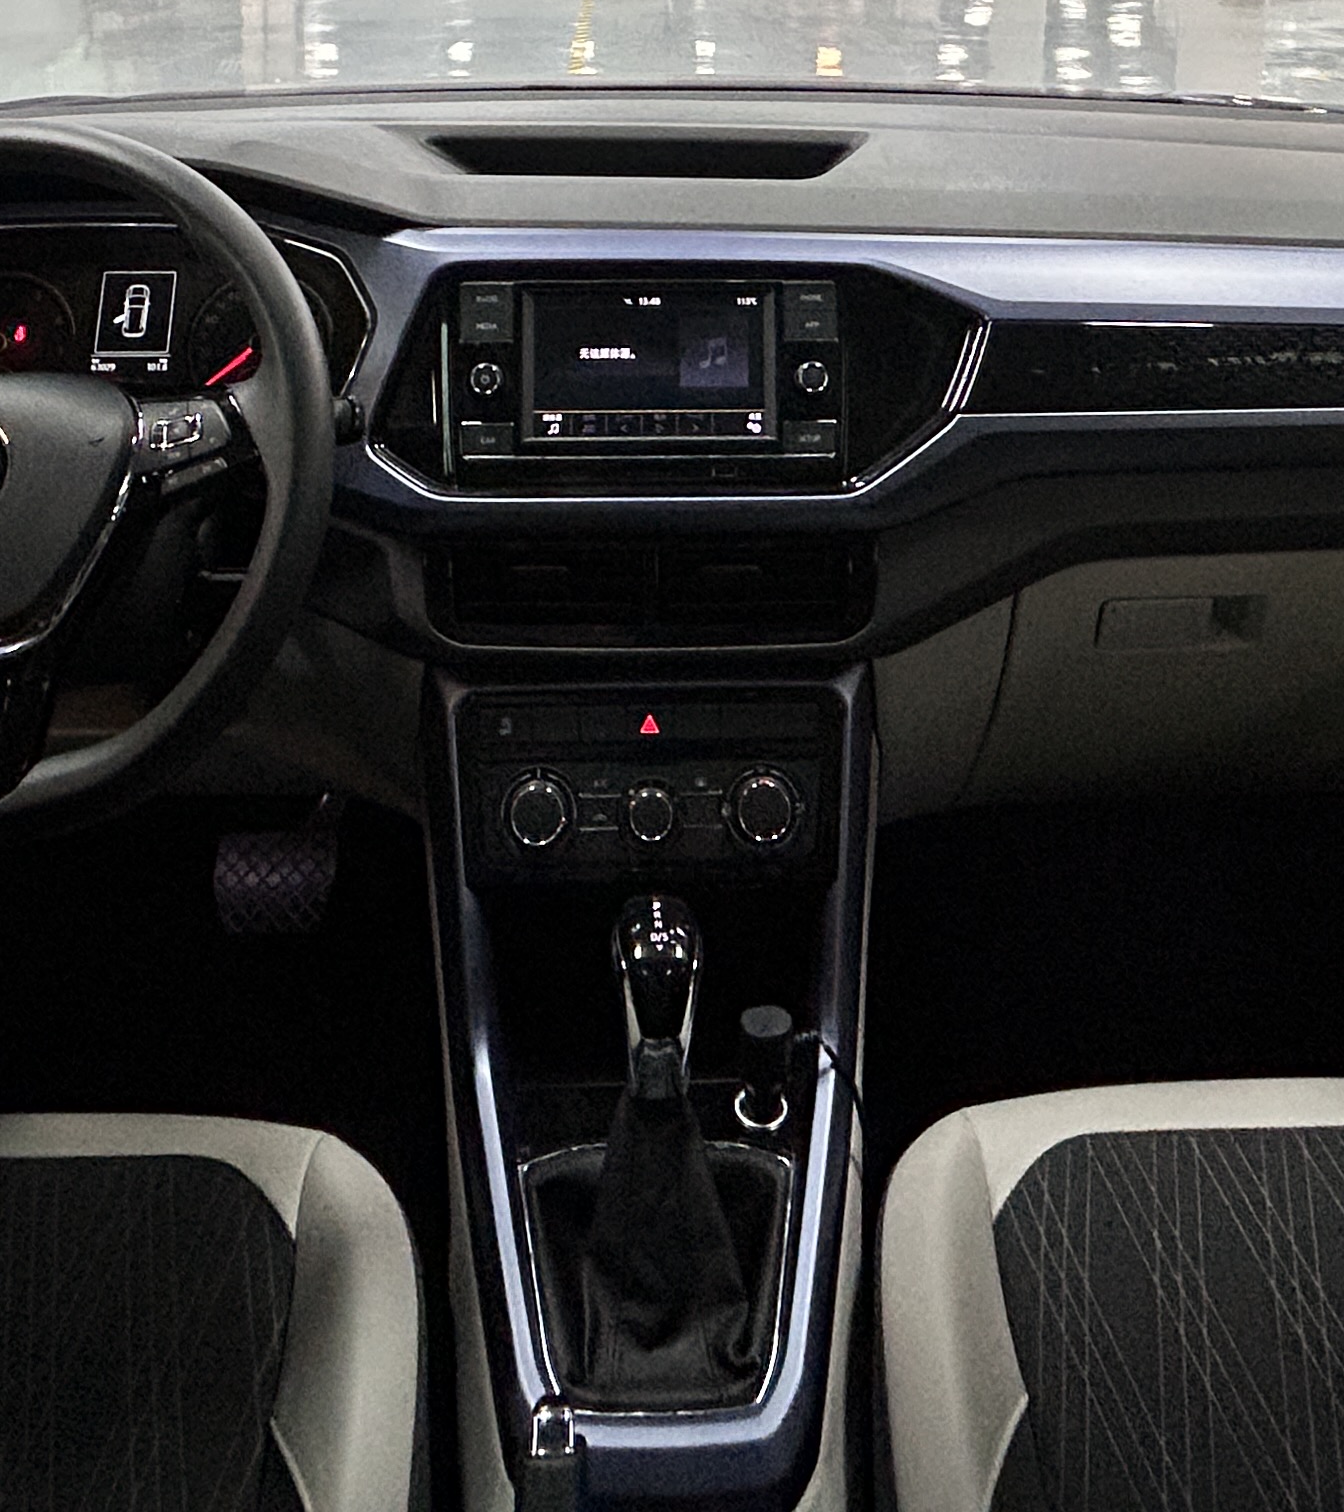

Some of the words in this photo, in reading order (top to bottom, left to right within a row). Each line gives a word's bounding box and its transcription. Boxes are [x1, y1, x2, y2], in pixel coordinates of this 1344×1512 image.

[652, 900, 662, 911] P
[653, 919, 663, 929] N
[649, 931, 669, 942] D/S
